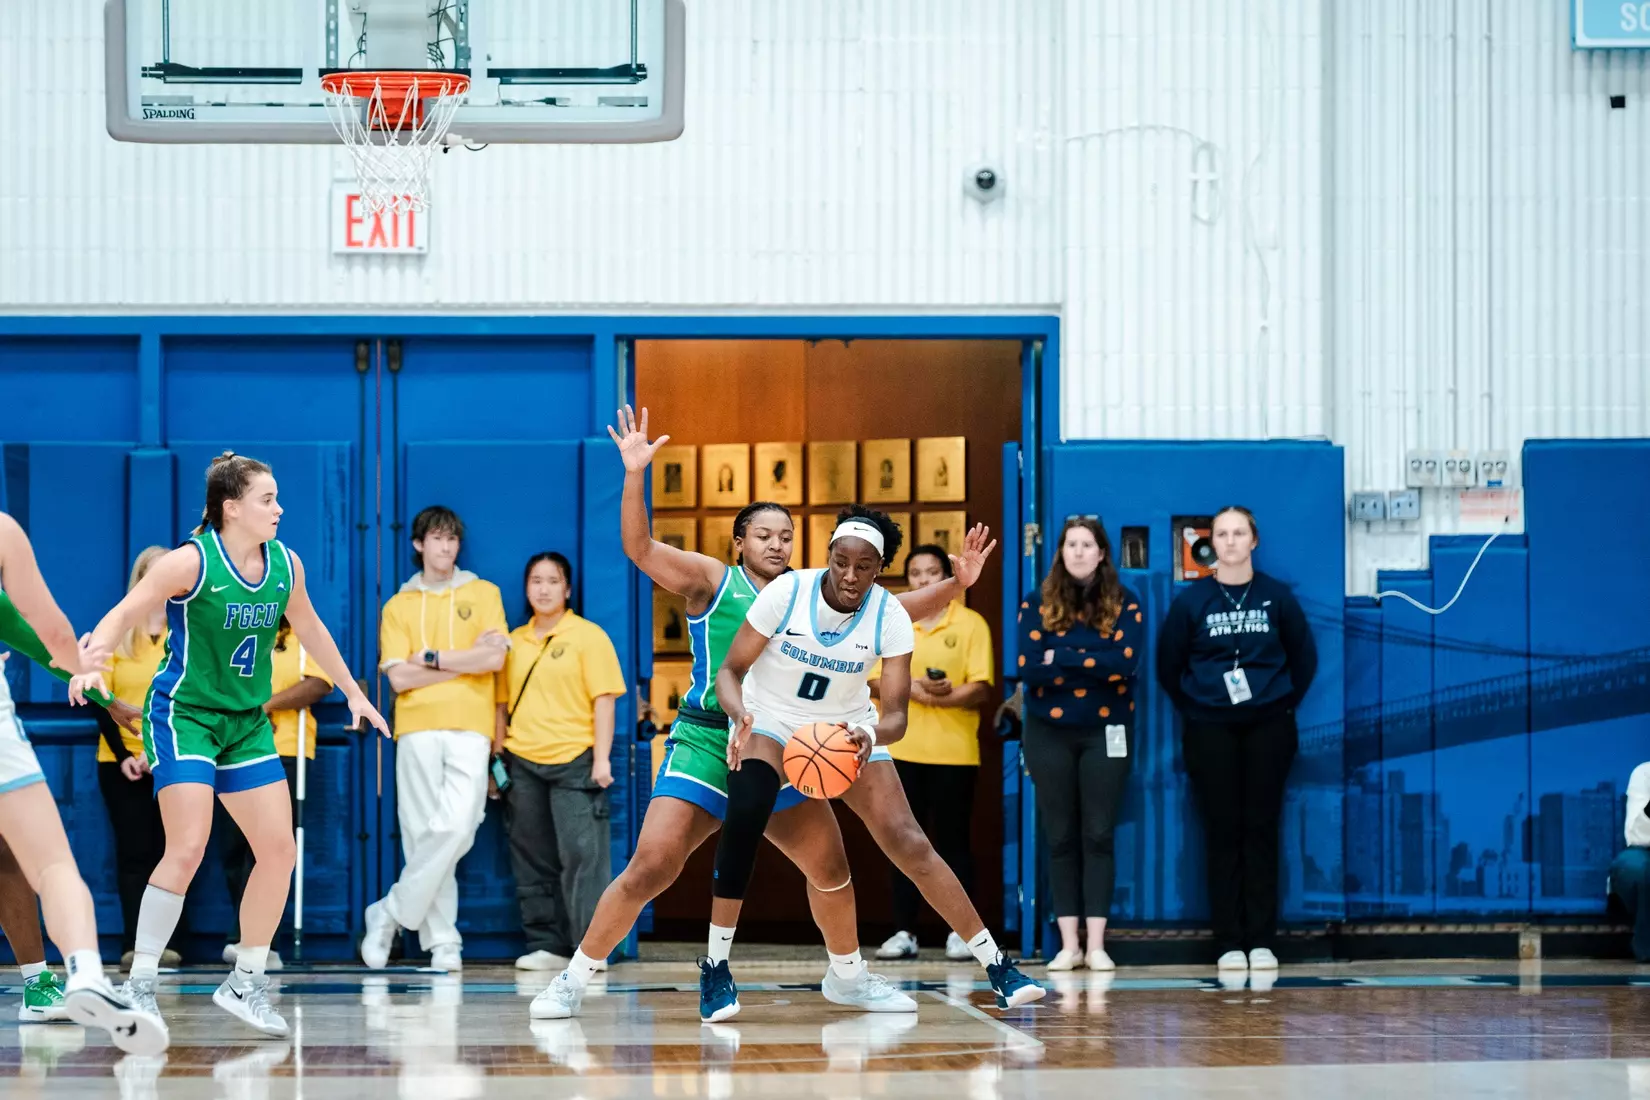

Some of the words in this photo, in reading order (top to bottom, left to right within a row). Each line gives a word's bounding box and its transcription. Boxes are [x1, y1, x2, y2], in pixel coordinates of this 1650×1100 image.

[142, 108, 195, 119] SPALDING
[345, 193, 420, 248] EXIT
[223, 602, 279, 629] FGCU
[229, 634, 258, 677] 4
[780, 641, 864, 673] COLUMBIA
[796, 671, 832, 702] 0
